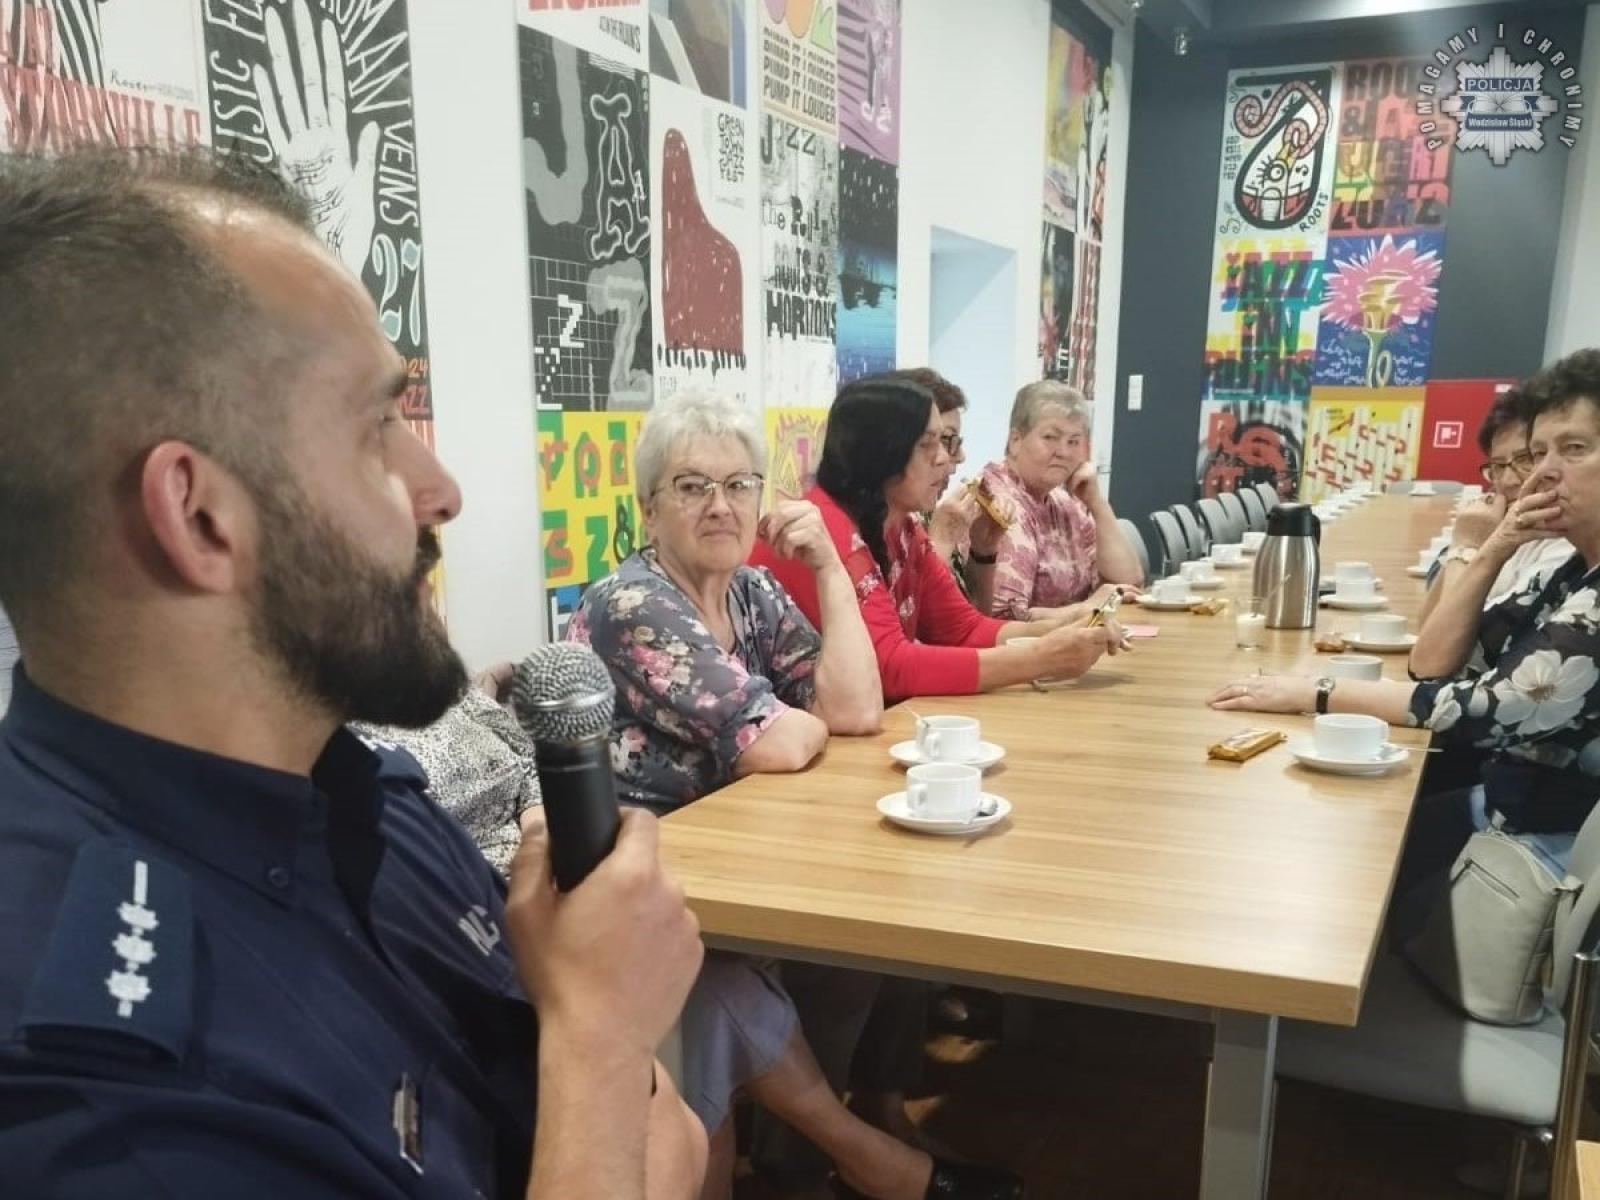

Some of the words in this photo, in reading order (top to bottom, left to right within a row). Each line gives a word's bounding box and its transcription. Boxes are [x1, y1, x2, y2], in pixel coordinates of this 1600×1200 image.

[763, 74, 790, 104] PUMP
[377, 119, 418, 225] VEINS
[1299, 193, 1329, 232] ROOTS
